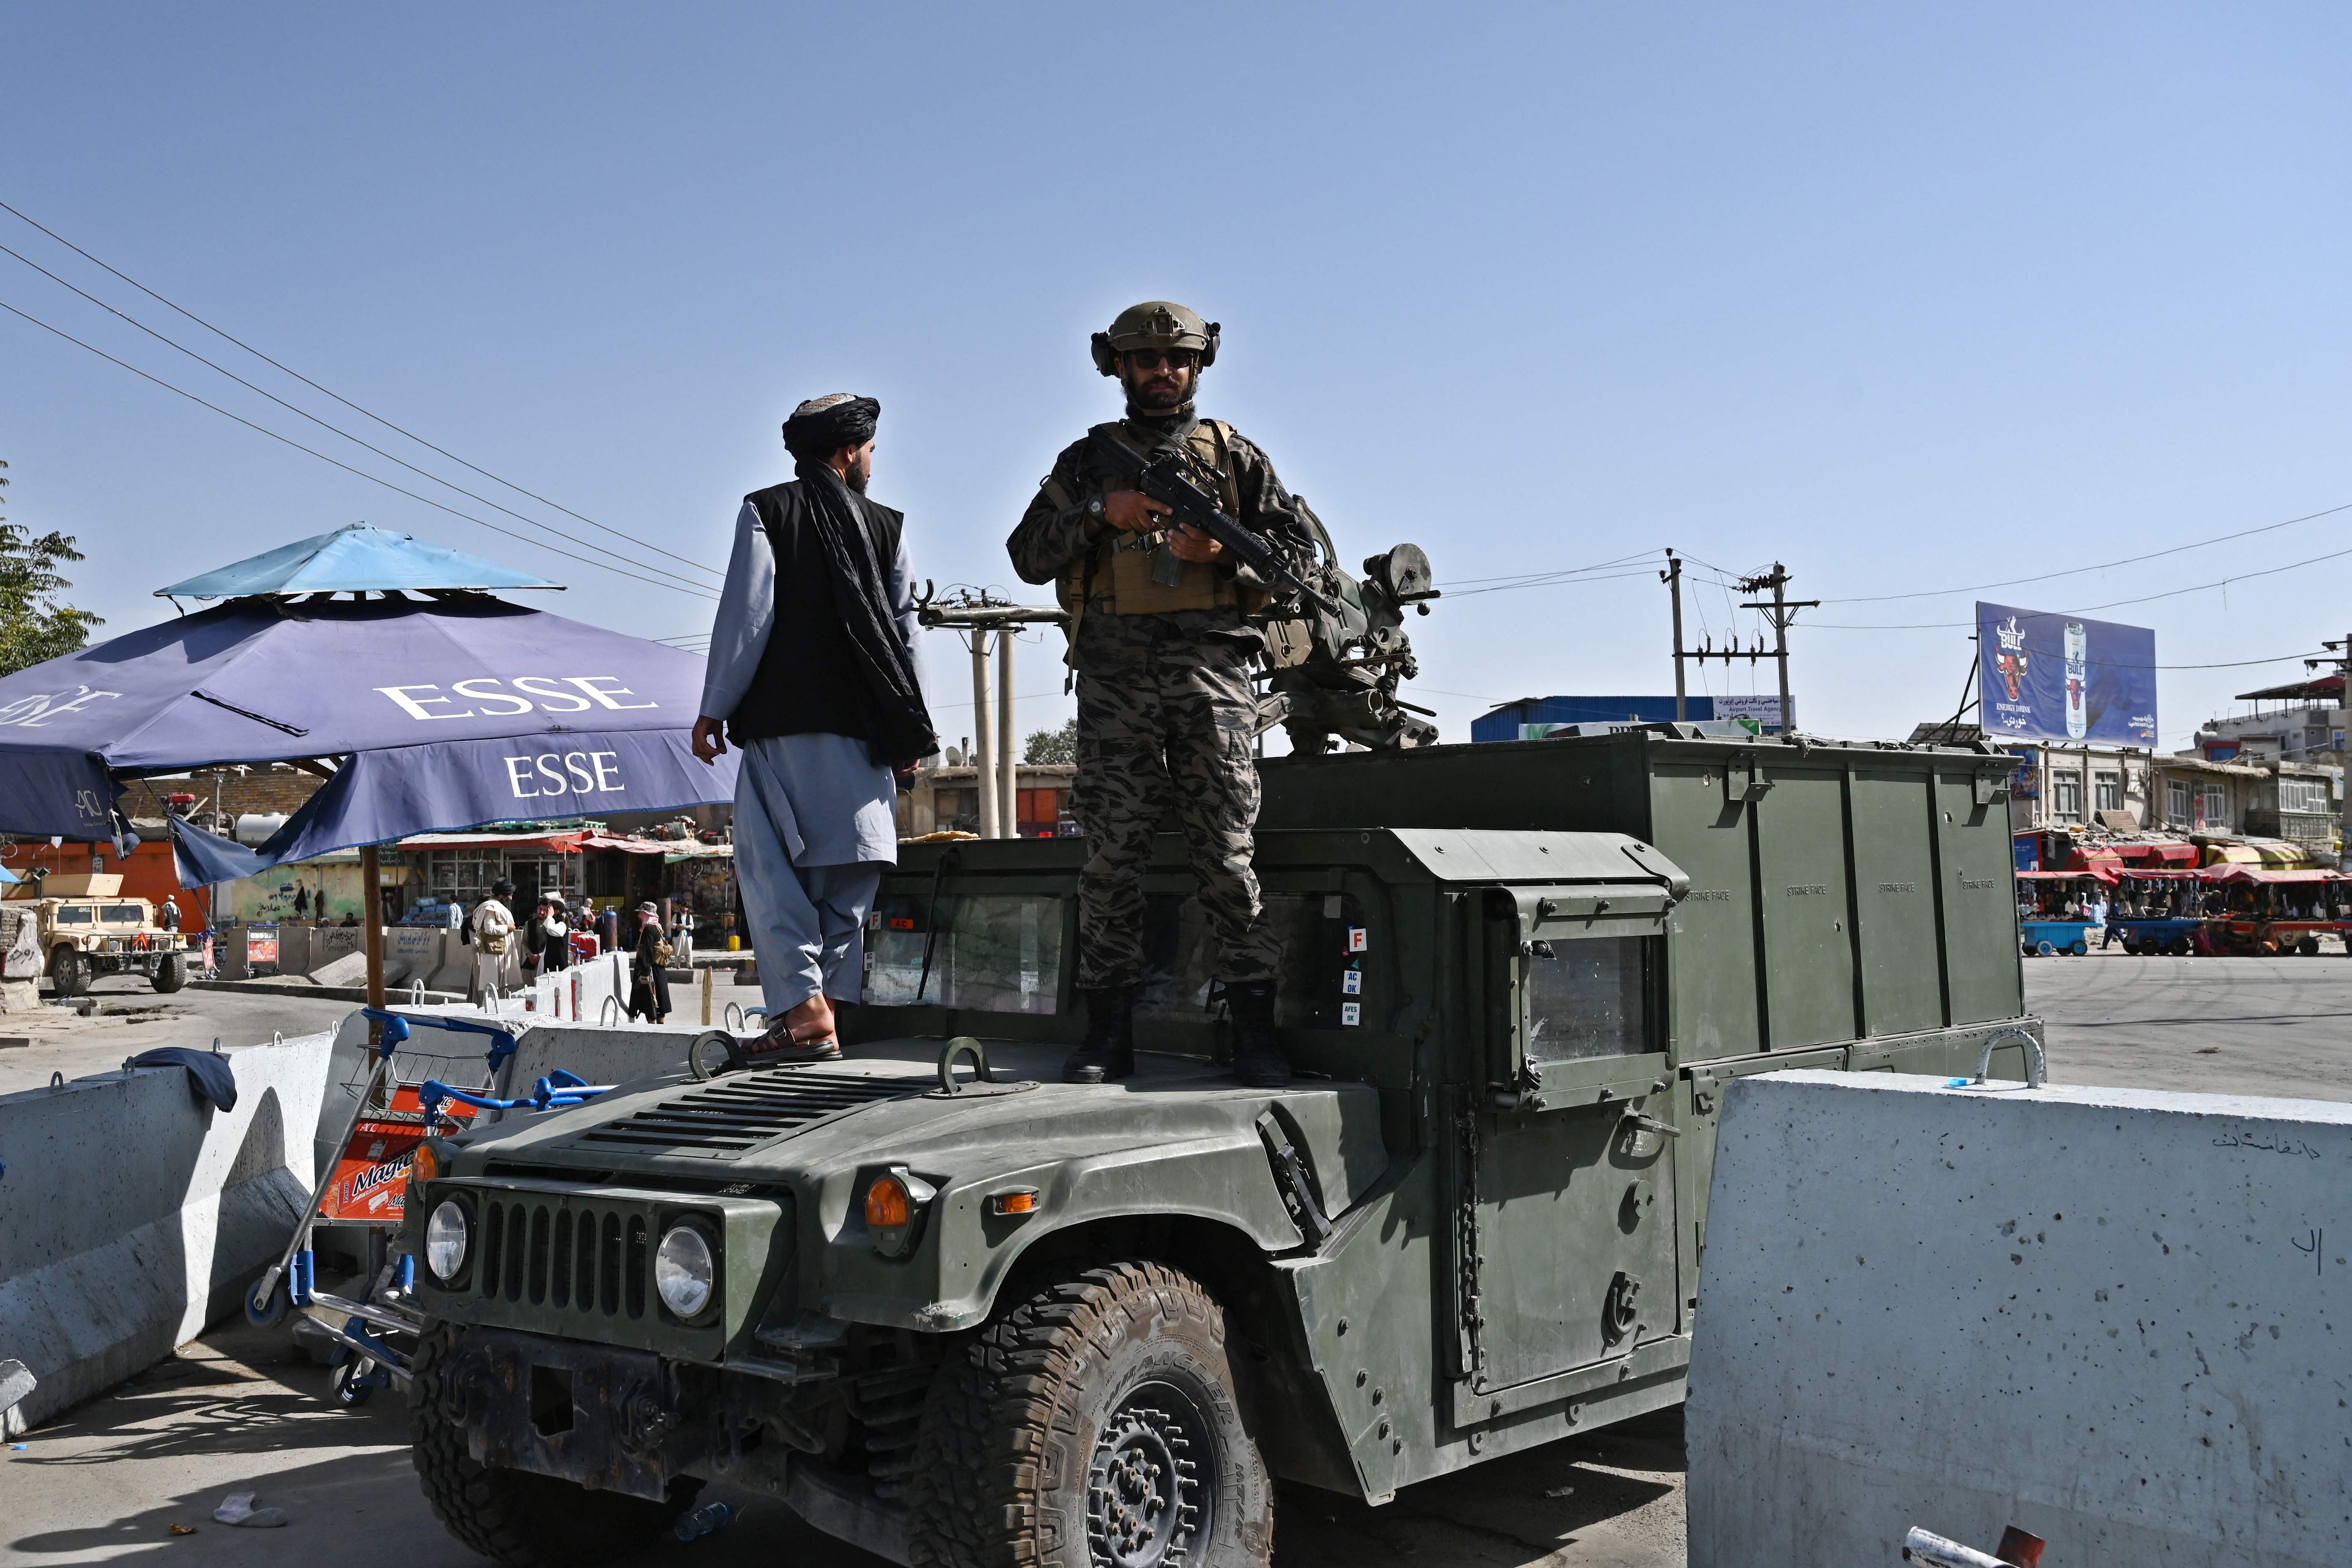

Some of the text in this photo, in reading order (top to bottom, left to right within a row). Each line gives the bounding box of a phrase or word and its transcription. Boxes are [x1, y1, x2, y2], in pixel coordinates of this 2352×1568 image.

[2000, 633, 2023, 651] BULL
[2068, 664, 2082, 675] BULL
[373, 676, 659, 720] ESSE
[1996, 703, 2030, 714] ENERGY DRINK
[504, 752, 625, 798] ESSE
[1787, 884, 1826, 897] STRIKE FACE
[1879, 882, 1915, 893] STRIKE FACE
[1963, 879, 1995, 889] STRIKE FACE
[1685, 889, 1730, 902] STRIKE FACE
[873, 914, 879, 926] F
[1354, 932, 1362, 947] F
[1347, 985, 1356, 993] OK
[352, 1150, 415, 1196] Magic
[365, 1185, 378, 1196] DRINK
[1102, 1350, 1234, 1424] WRANGLER
[1234, 1462, 1245, 1539] MT/R
